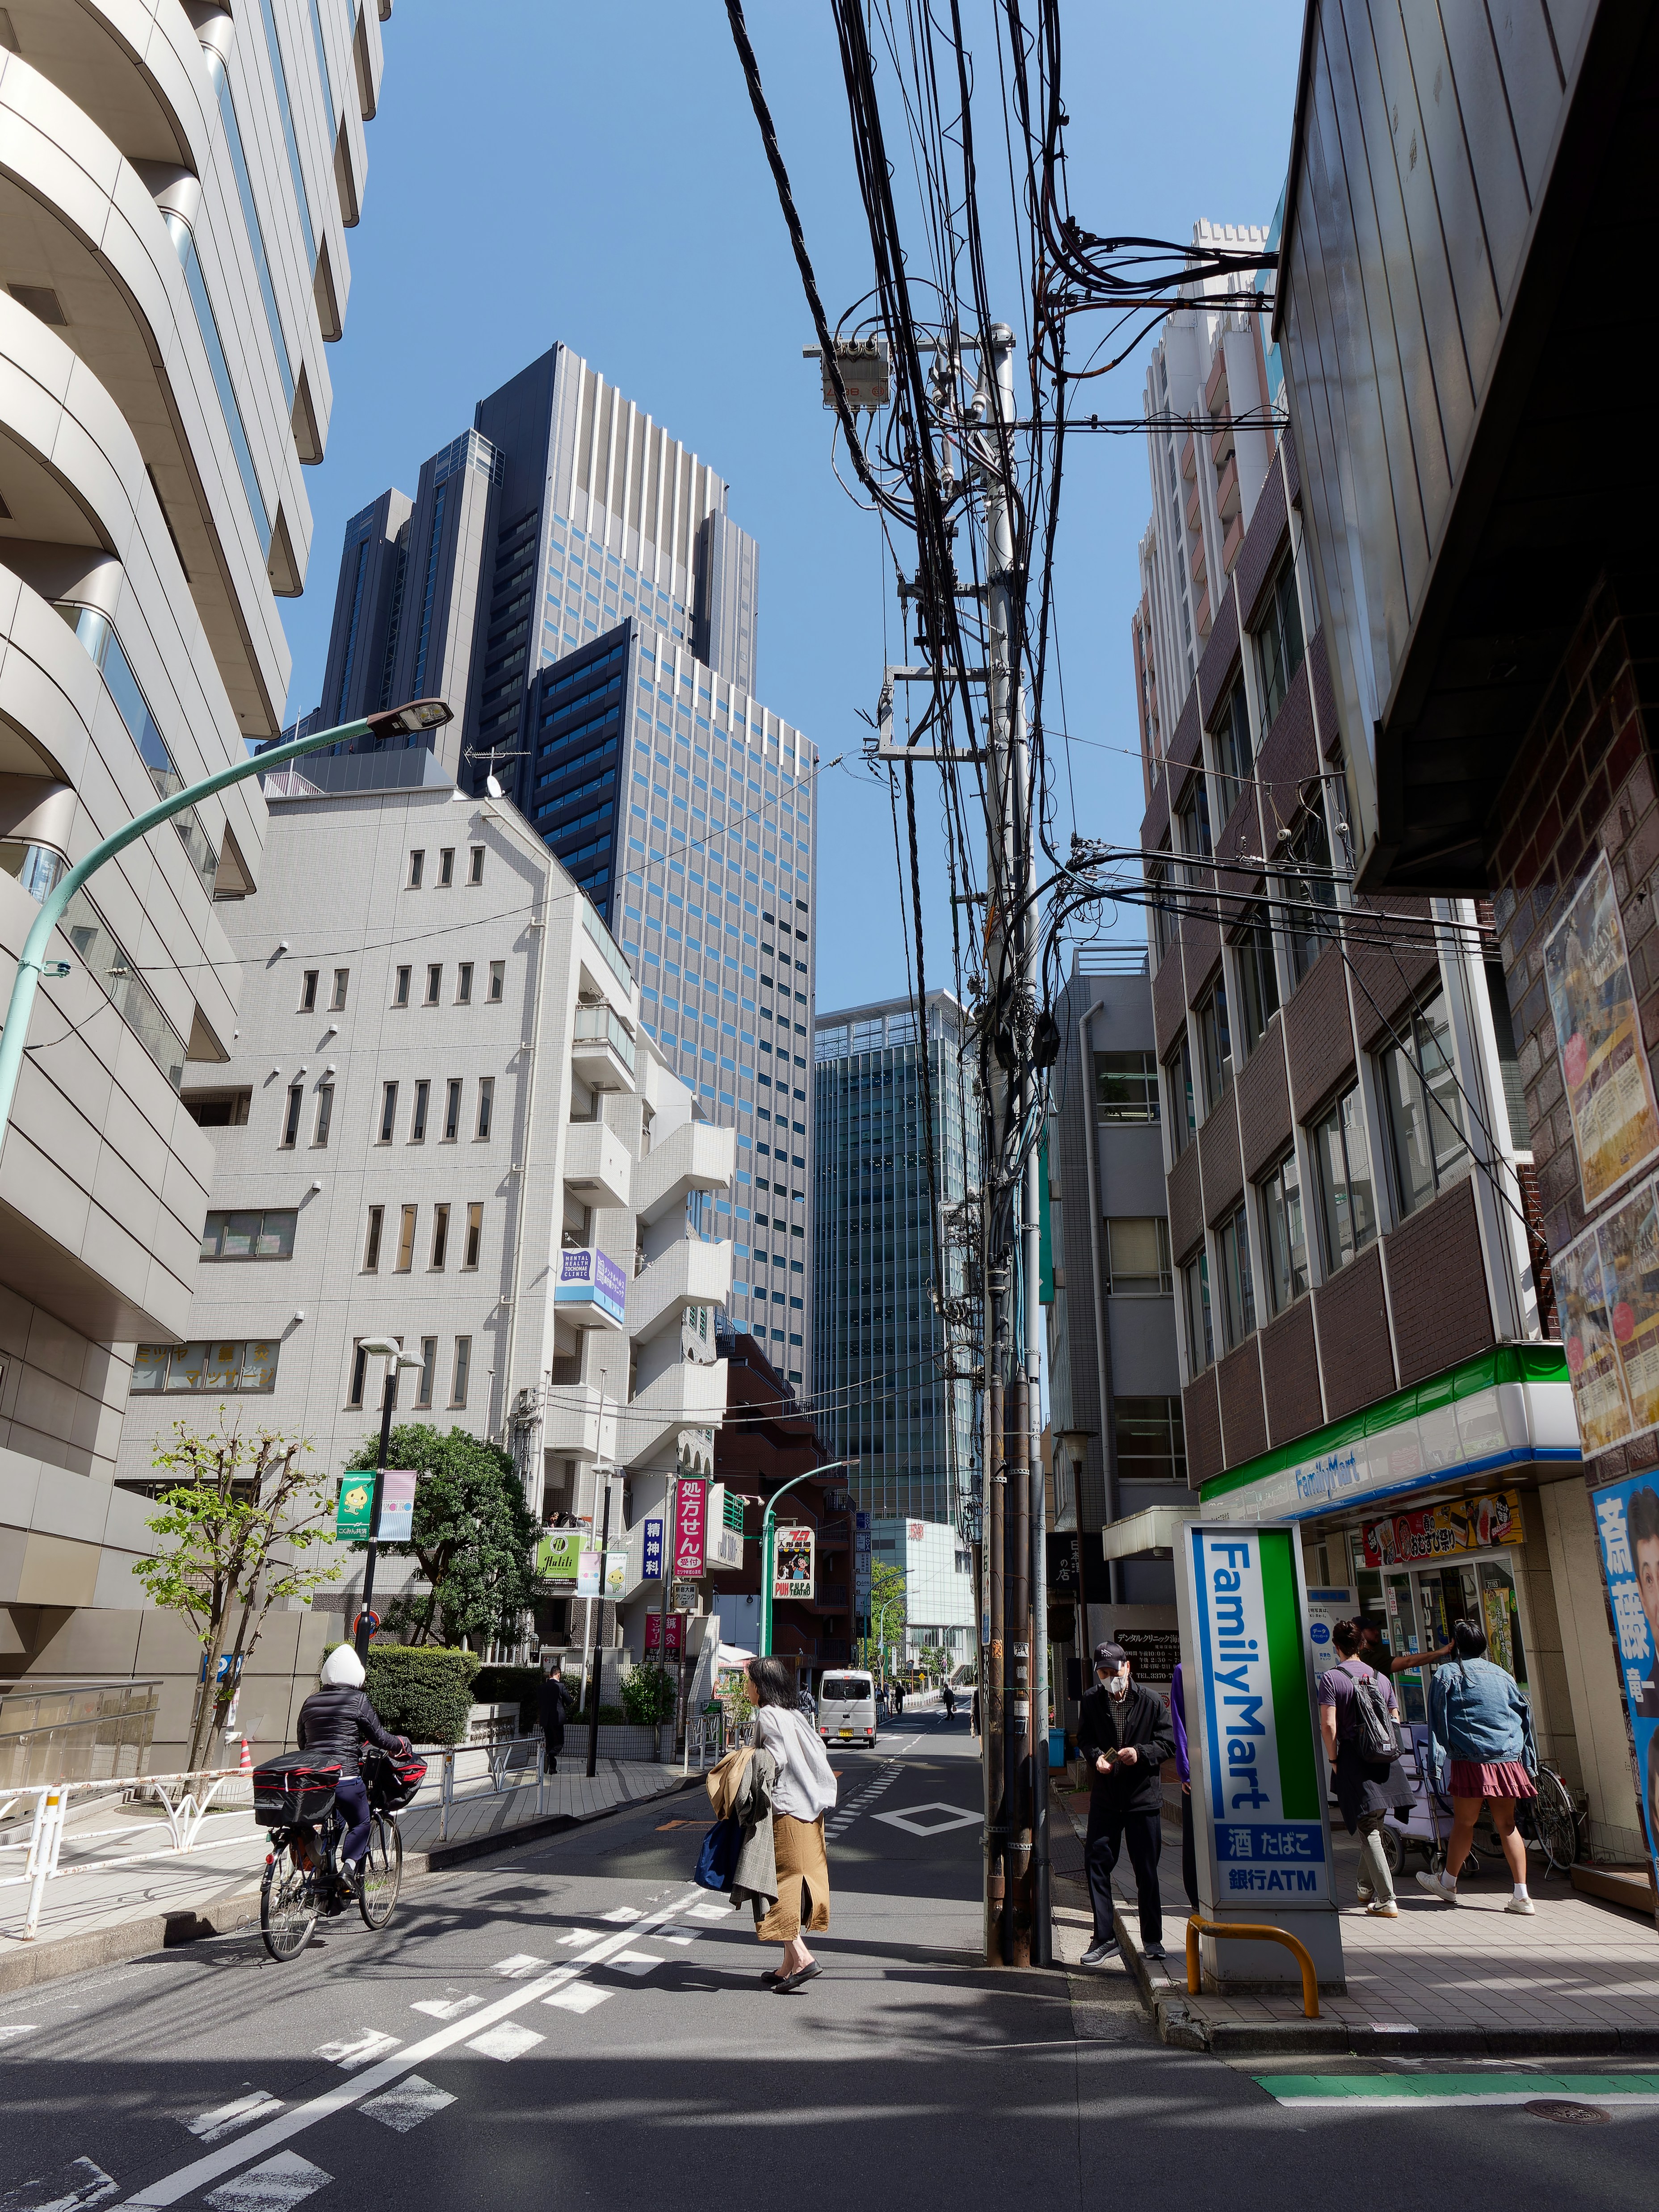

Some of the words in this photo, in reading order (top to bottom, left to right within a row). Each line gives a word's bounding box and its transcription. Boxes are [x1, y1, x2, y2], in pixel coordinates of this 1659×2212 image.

[605, 1267, 624, 1290] メンタルヘルス
[1295, 1450, 1361, 1500] FamilyMart
[680, 1482, 701, 1554] 処方せん
[1423, 1514, 1436, 1534] 春の
[646, 1523, 660, 1575] 精神科
[1411, 1527, 1456, 1557] おむすび祭り
[544, 1555, 573, 1572] Hulili
[680, 1558, 698, 1566] 受付
[1056, 1559, 1070, 1581] の店
[775, 1582, 789, 1596] PUK
[651, 1617, 661, 1645] マッサージ
[666, 1617, 676, 1645] 鍼灸
[1211, 1542, 1270, 1810] FamilyMart
[1626, 1667, 1655, 1703] 竜一
[1228, 1829, 1252, 1858] 酒
[1260, 1832, 1311, 1856] たばこ
[1229, 1868, 1317, 1891] 銀行ATM
